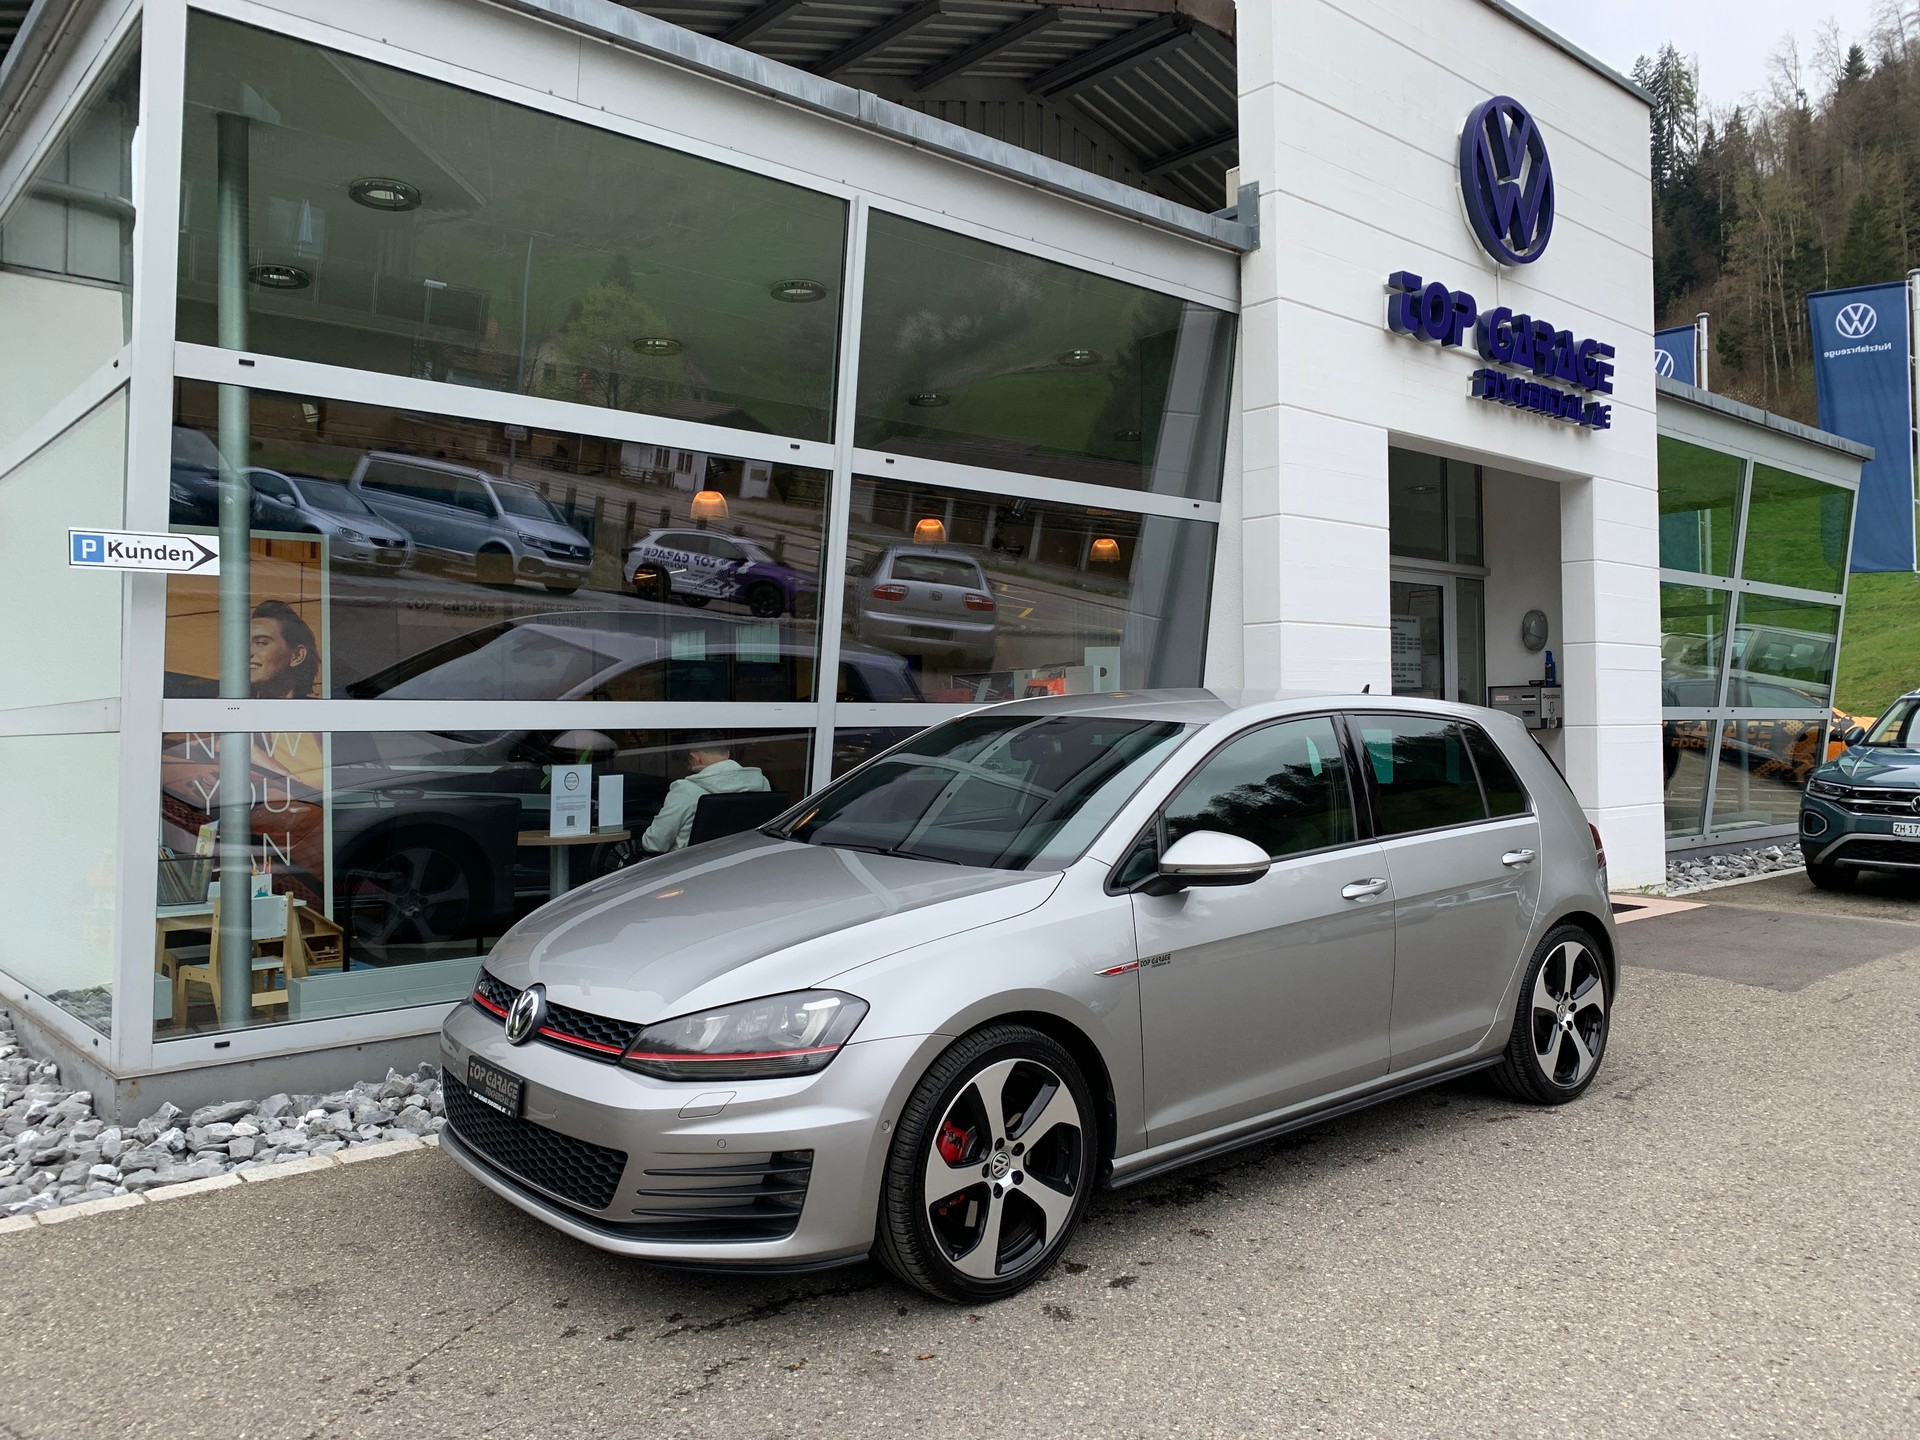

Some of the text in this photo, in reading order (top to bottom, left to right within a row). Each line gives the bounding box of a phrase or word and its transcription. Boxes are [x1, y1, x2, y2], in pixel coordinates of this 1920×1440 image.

[1388, 271, 1615, 395] TOP GARAGE
[107, 541, 194, 562] Kunden
[186, 733, 302, 760] NW
[194, 776, 291, 815] YU
[470, 1061, 519, 1100] TOP GARAGE
